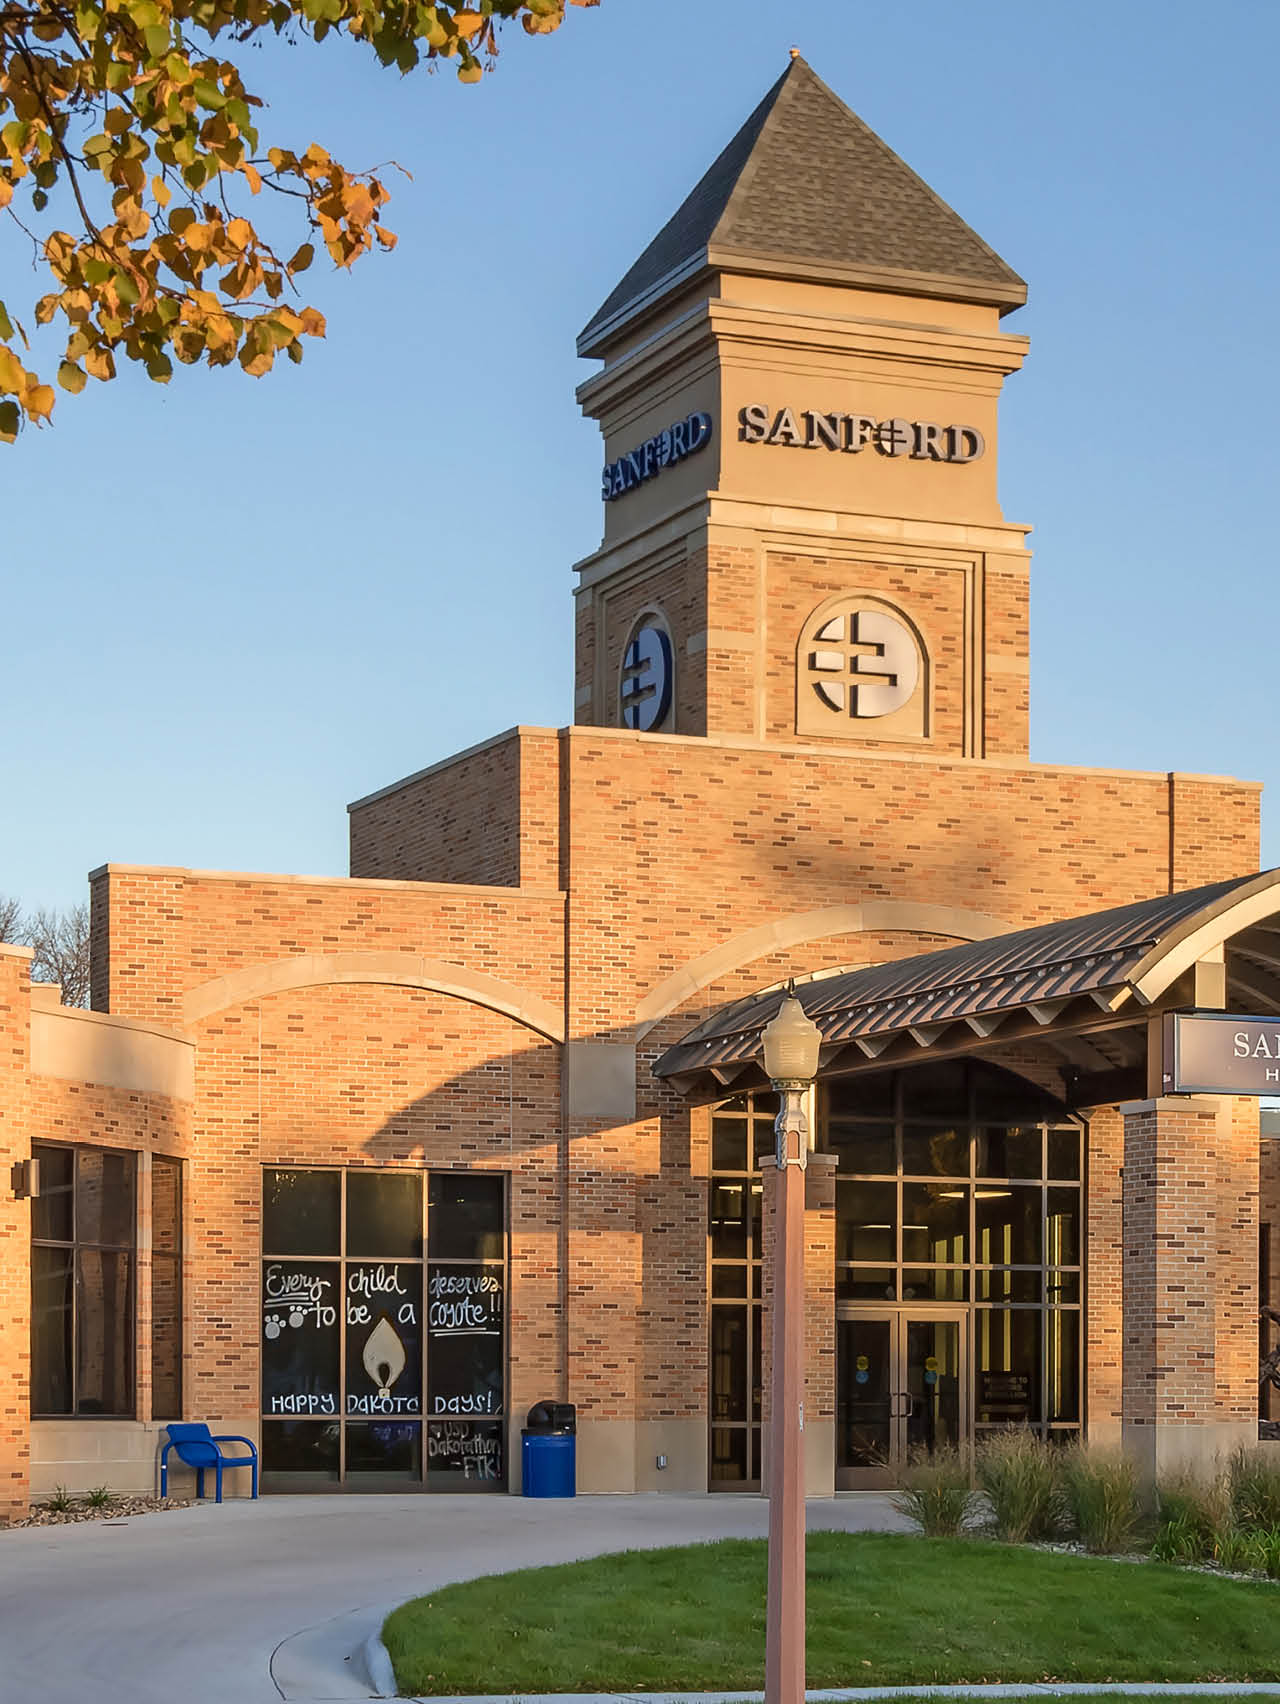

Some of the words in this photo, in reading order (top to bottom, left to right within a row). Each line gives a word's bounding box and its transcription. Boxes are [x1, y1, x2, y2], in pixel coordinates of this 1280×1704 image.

[602, 411, 713, 501] SANFORD
[739, 404, 985, 463] SANFORD
[266, 1265, 331, 1300] Every
[348, 1264, 407, 1298] child
[429, 1269, 502, 1298] deserves
[308, 1300, 336, 1328] to
[346, 1297, 372, 1325] be
[397, 1303, 417, 1324] a
